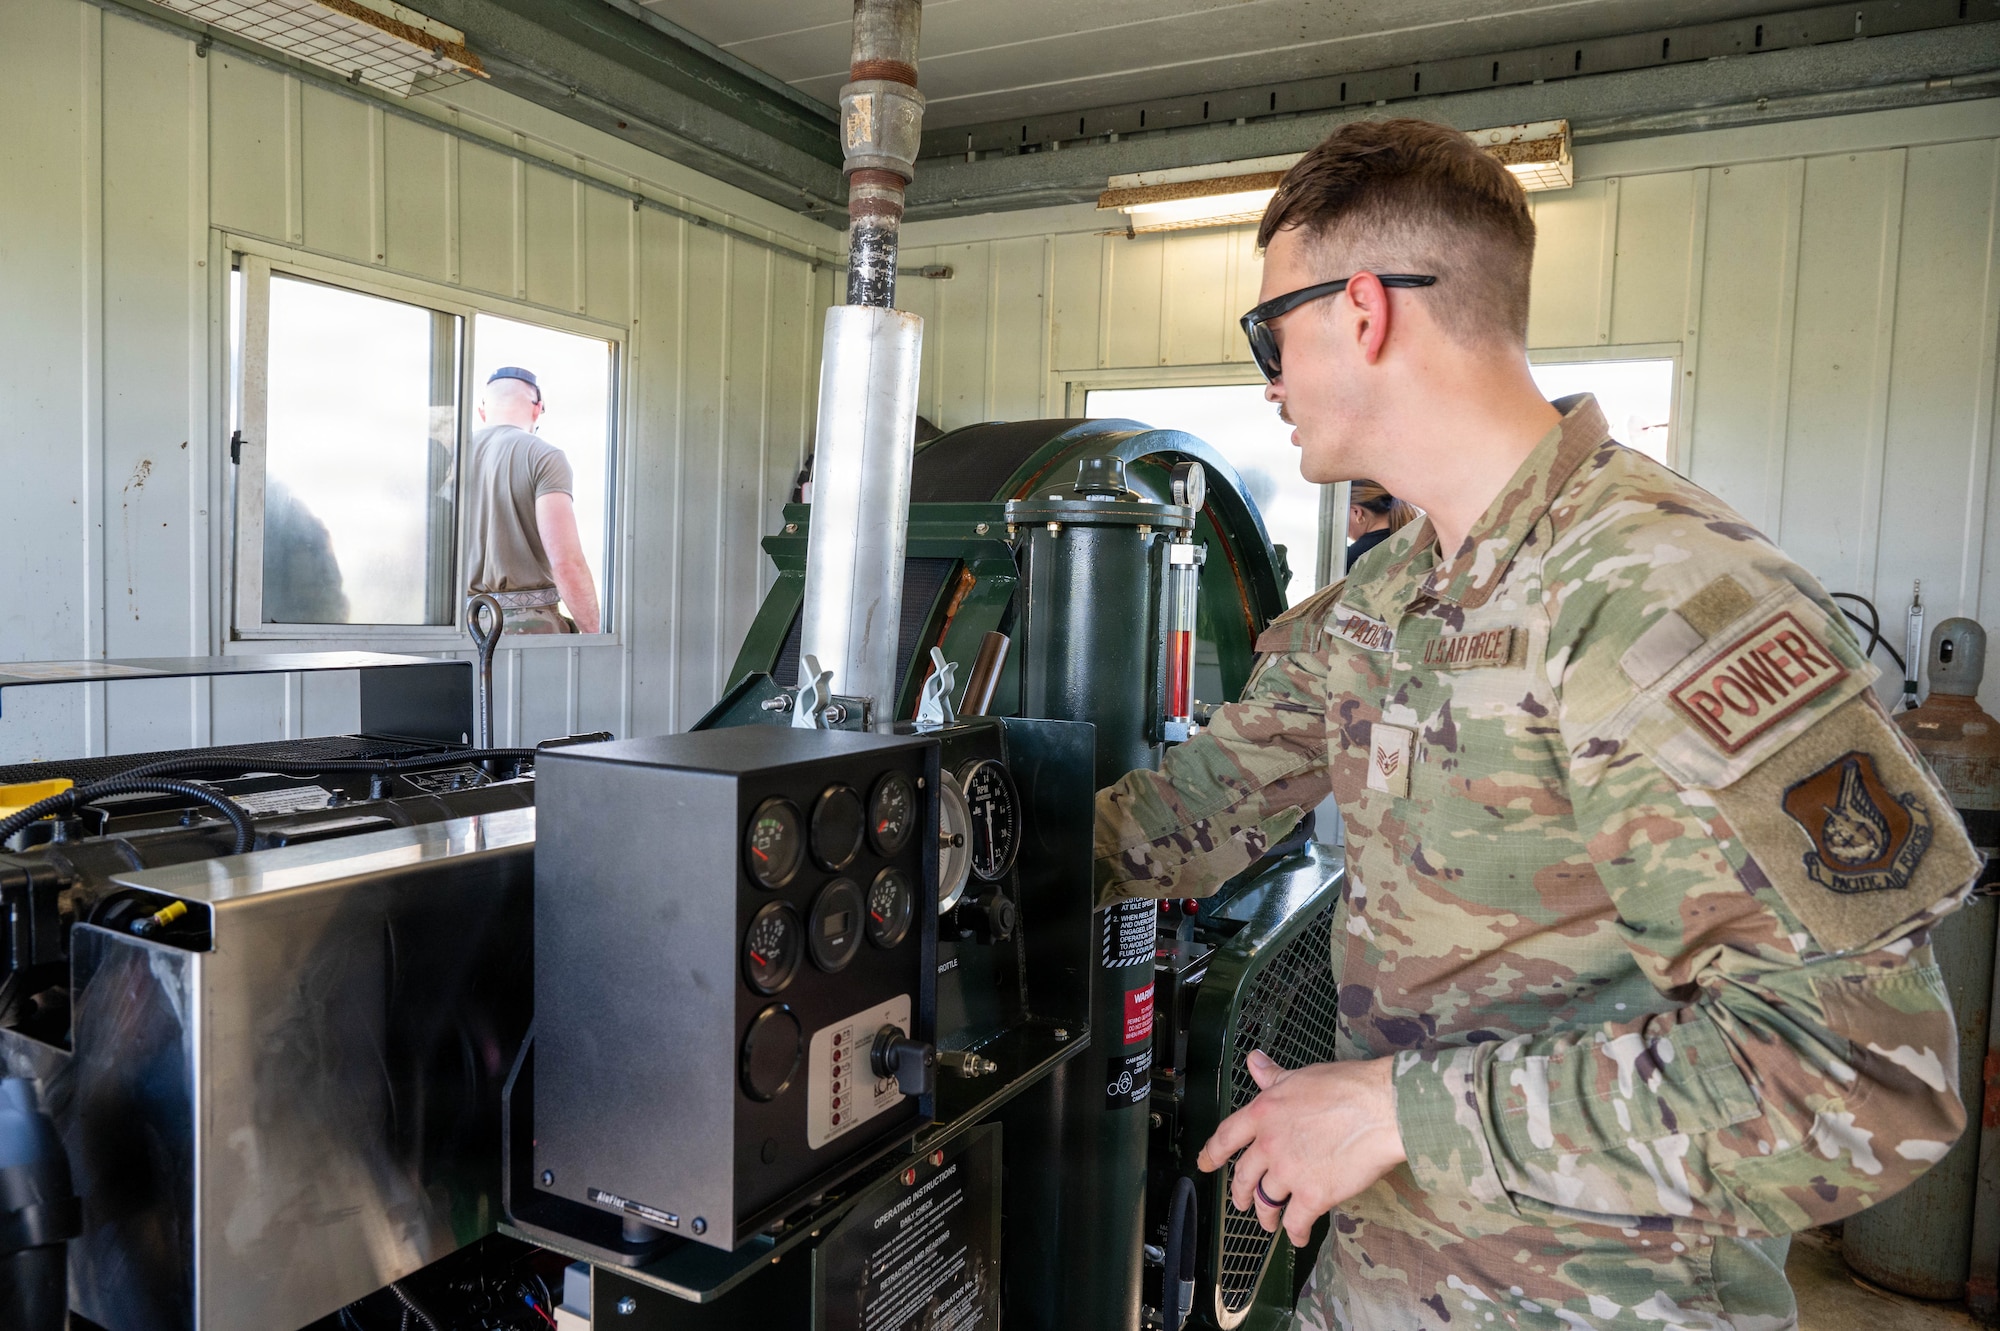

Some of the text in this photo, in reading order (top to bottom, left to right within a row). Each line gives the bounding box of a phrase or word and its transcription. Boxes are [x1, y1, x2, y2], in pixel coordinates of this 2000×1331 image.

[1687, 629, 1831, 737] POWER
[977, 785, 989, 795] RPM
[1832, 874, 1882, 890] PACIFIC
[1130, 902, 1141, 910] IDLE
[1121, 914, 1138, 922] WHEN
[1129, 940, 1144, 948] AVOID
[1119, 949, 1135, 957] FLUID
[874, 1164, 956, 1229] OPERATING INSTRUCTIONS
[900, 1198, 933, 1229] DAILY CHECK
[879, 1257, 914, 1292] RETRACTION
[913, 1249, 925, 1265] AND
[924, 1229, 950, 1254] READYING
[932, 1285, 965, 1320] OPERATOR
